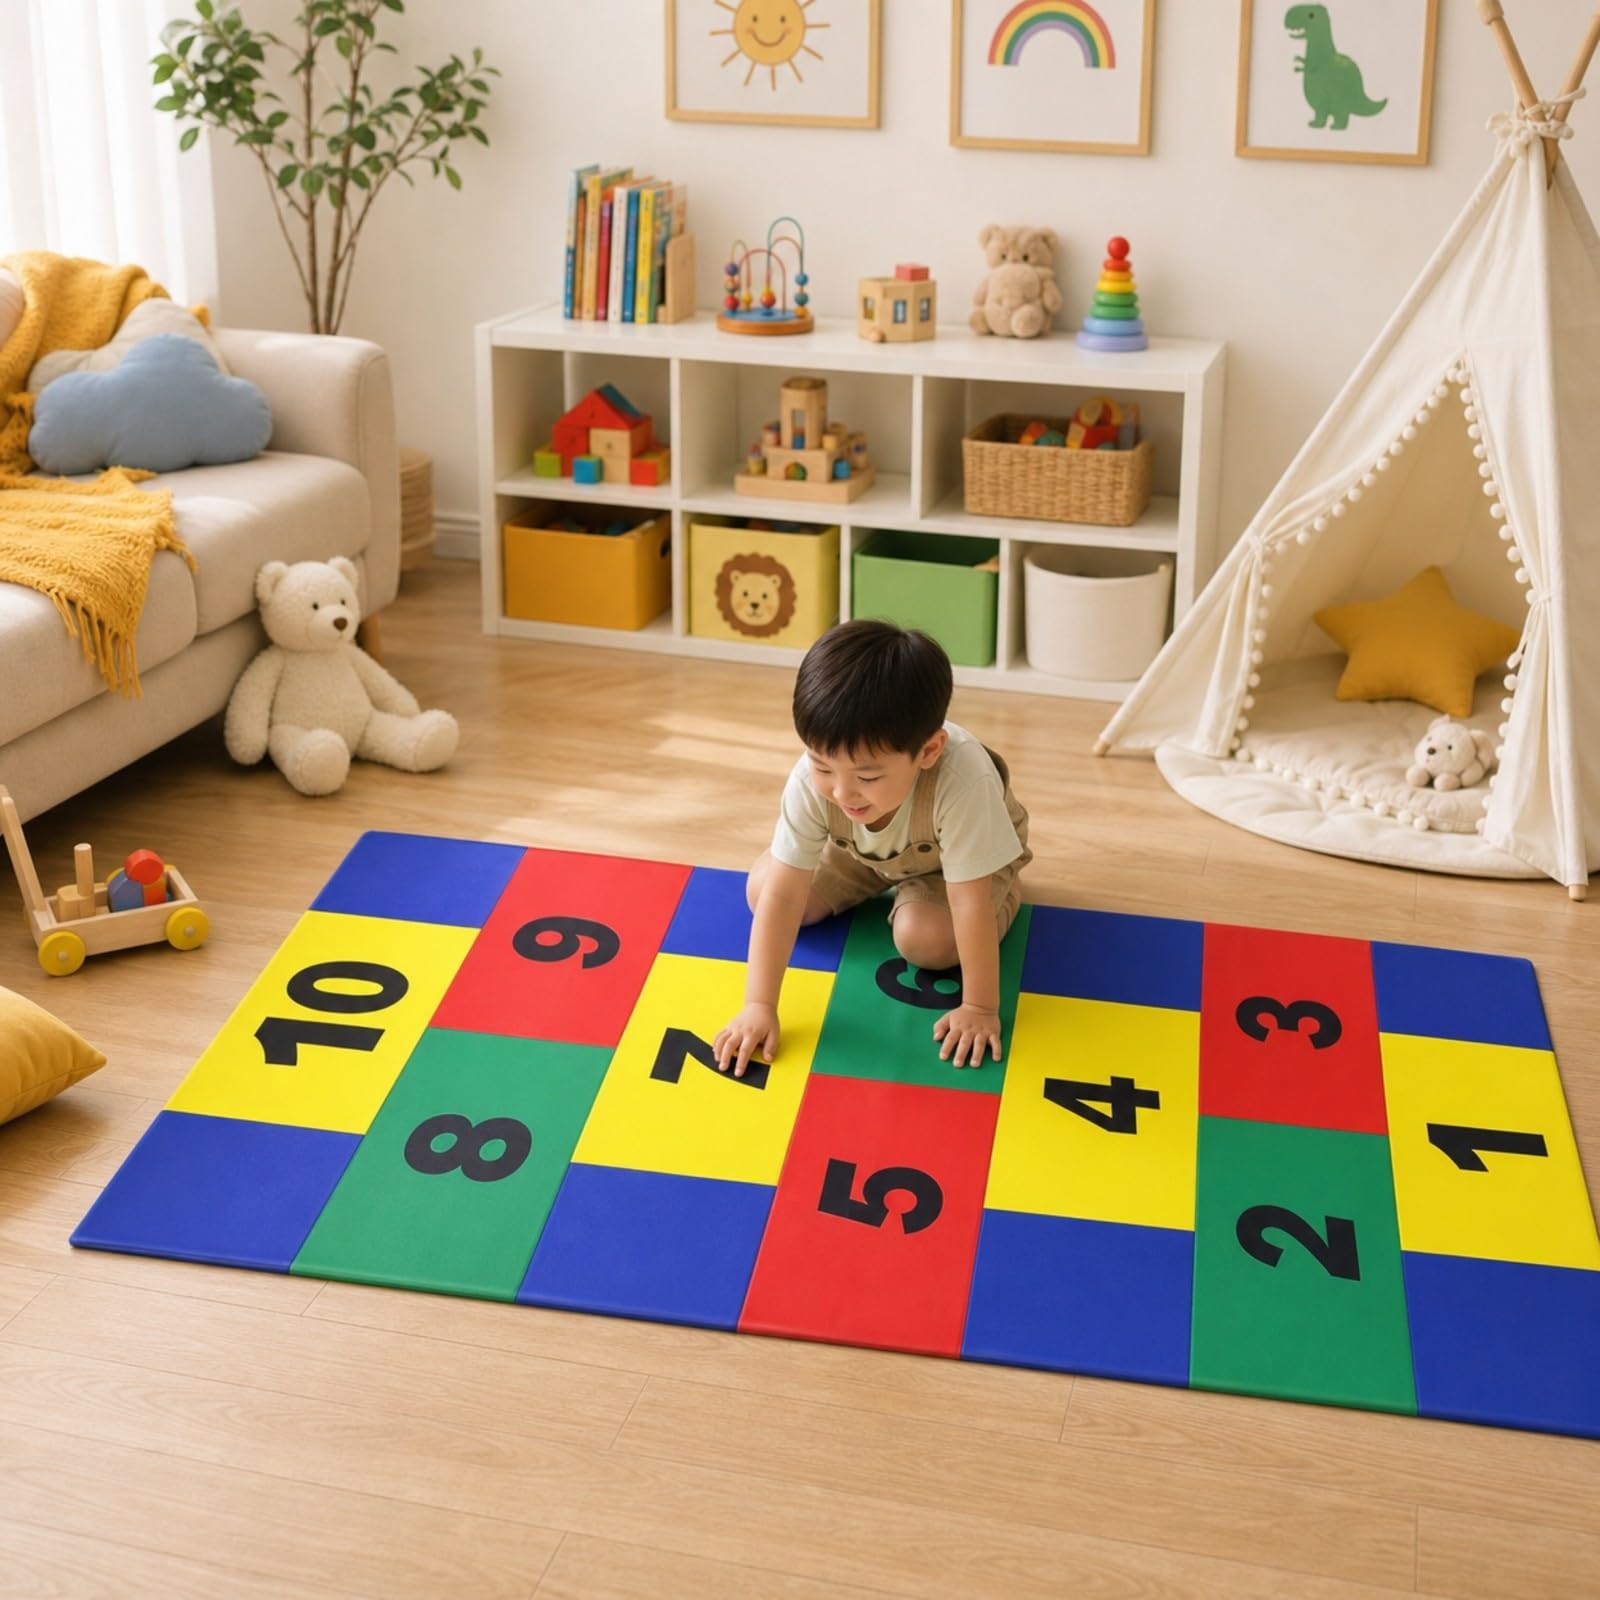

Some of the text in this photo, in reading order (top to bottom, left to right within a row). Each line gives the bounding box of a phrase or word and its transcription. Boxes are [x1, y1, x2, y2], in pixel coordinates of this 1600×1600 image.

[512, 916, 620, 970] 9
[254, 961, 409, 1066] 10
[874, 956, 963, 1011] 6
[1235, 995, 1342, 1050] 3
[650, 1028, 771, 1090] 7
[1043, 1075, 1160, 1135] 4
[404, 1113, 532, 1182] 8
[1426, 1123, 1549, 1173] 1
[818, 1158, 944, 1234] 5
[1235, 1204, 1361, 1282] 2
